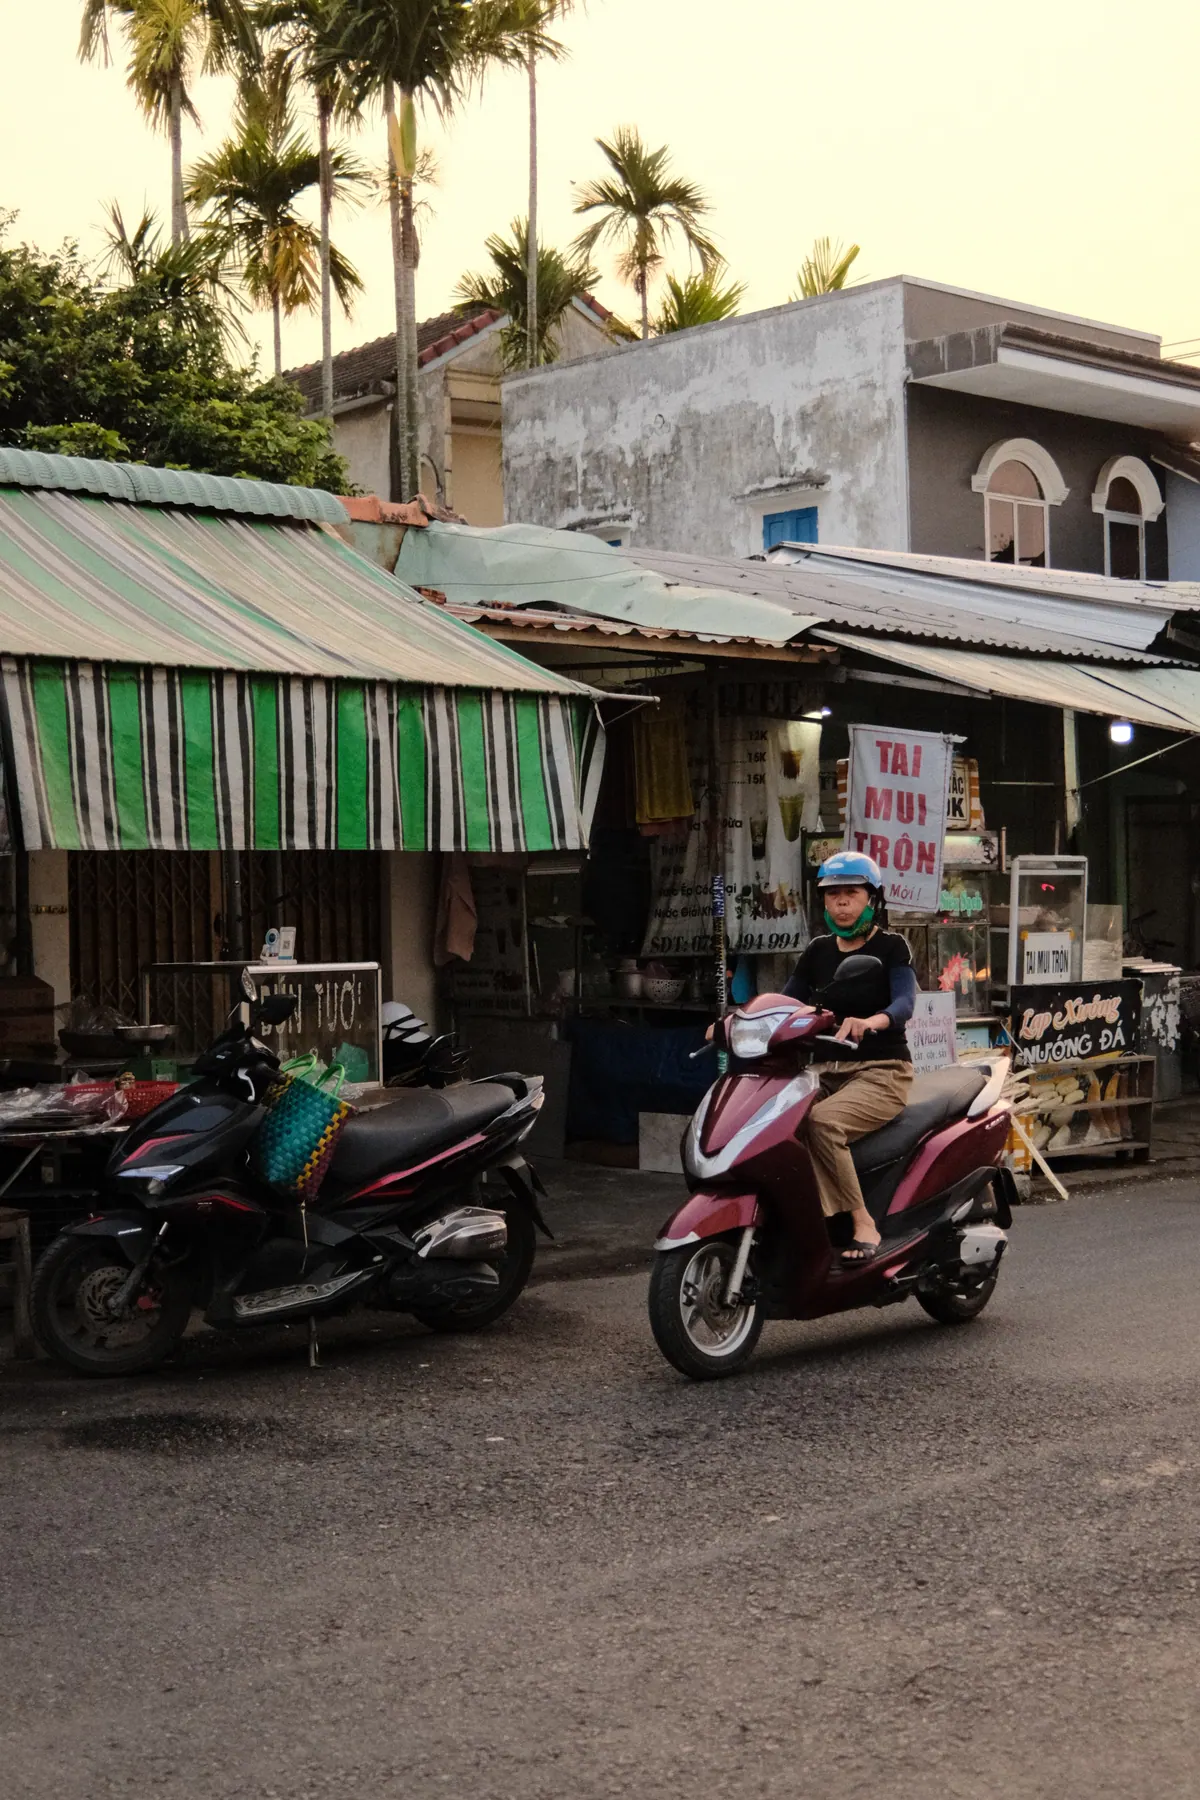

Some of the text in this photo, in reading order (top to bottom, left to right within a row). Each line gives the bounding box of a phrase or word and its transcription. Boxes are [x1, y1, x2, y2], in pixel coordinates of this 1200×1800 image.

[748, 730, 768, 741] 12K
[875, 740, 922, 778] TAI
[746, 773, 766, 785] 15K
[864, 786, 927, 826] MUI
[854, 831, 936, 877] TRỘN
[768, 932, 799, 949] 994
[1026, 945, 1069, 978] TAI MUI TRỘN
[914, 1029, 948, 1047] Nhanh
[1023, 1019, 1126, 1064] NƯỚNG ĐÁ
